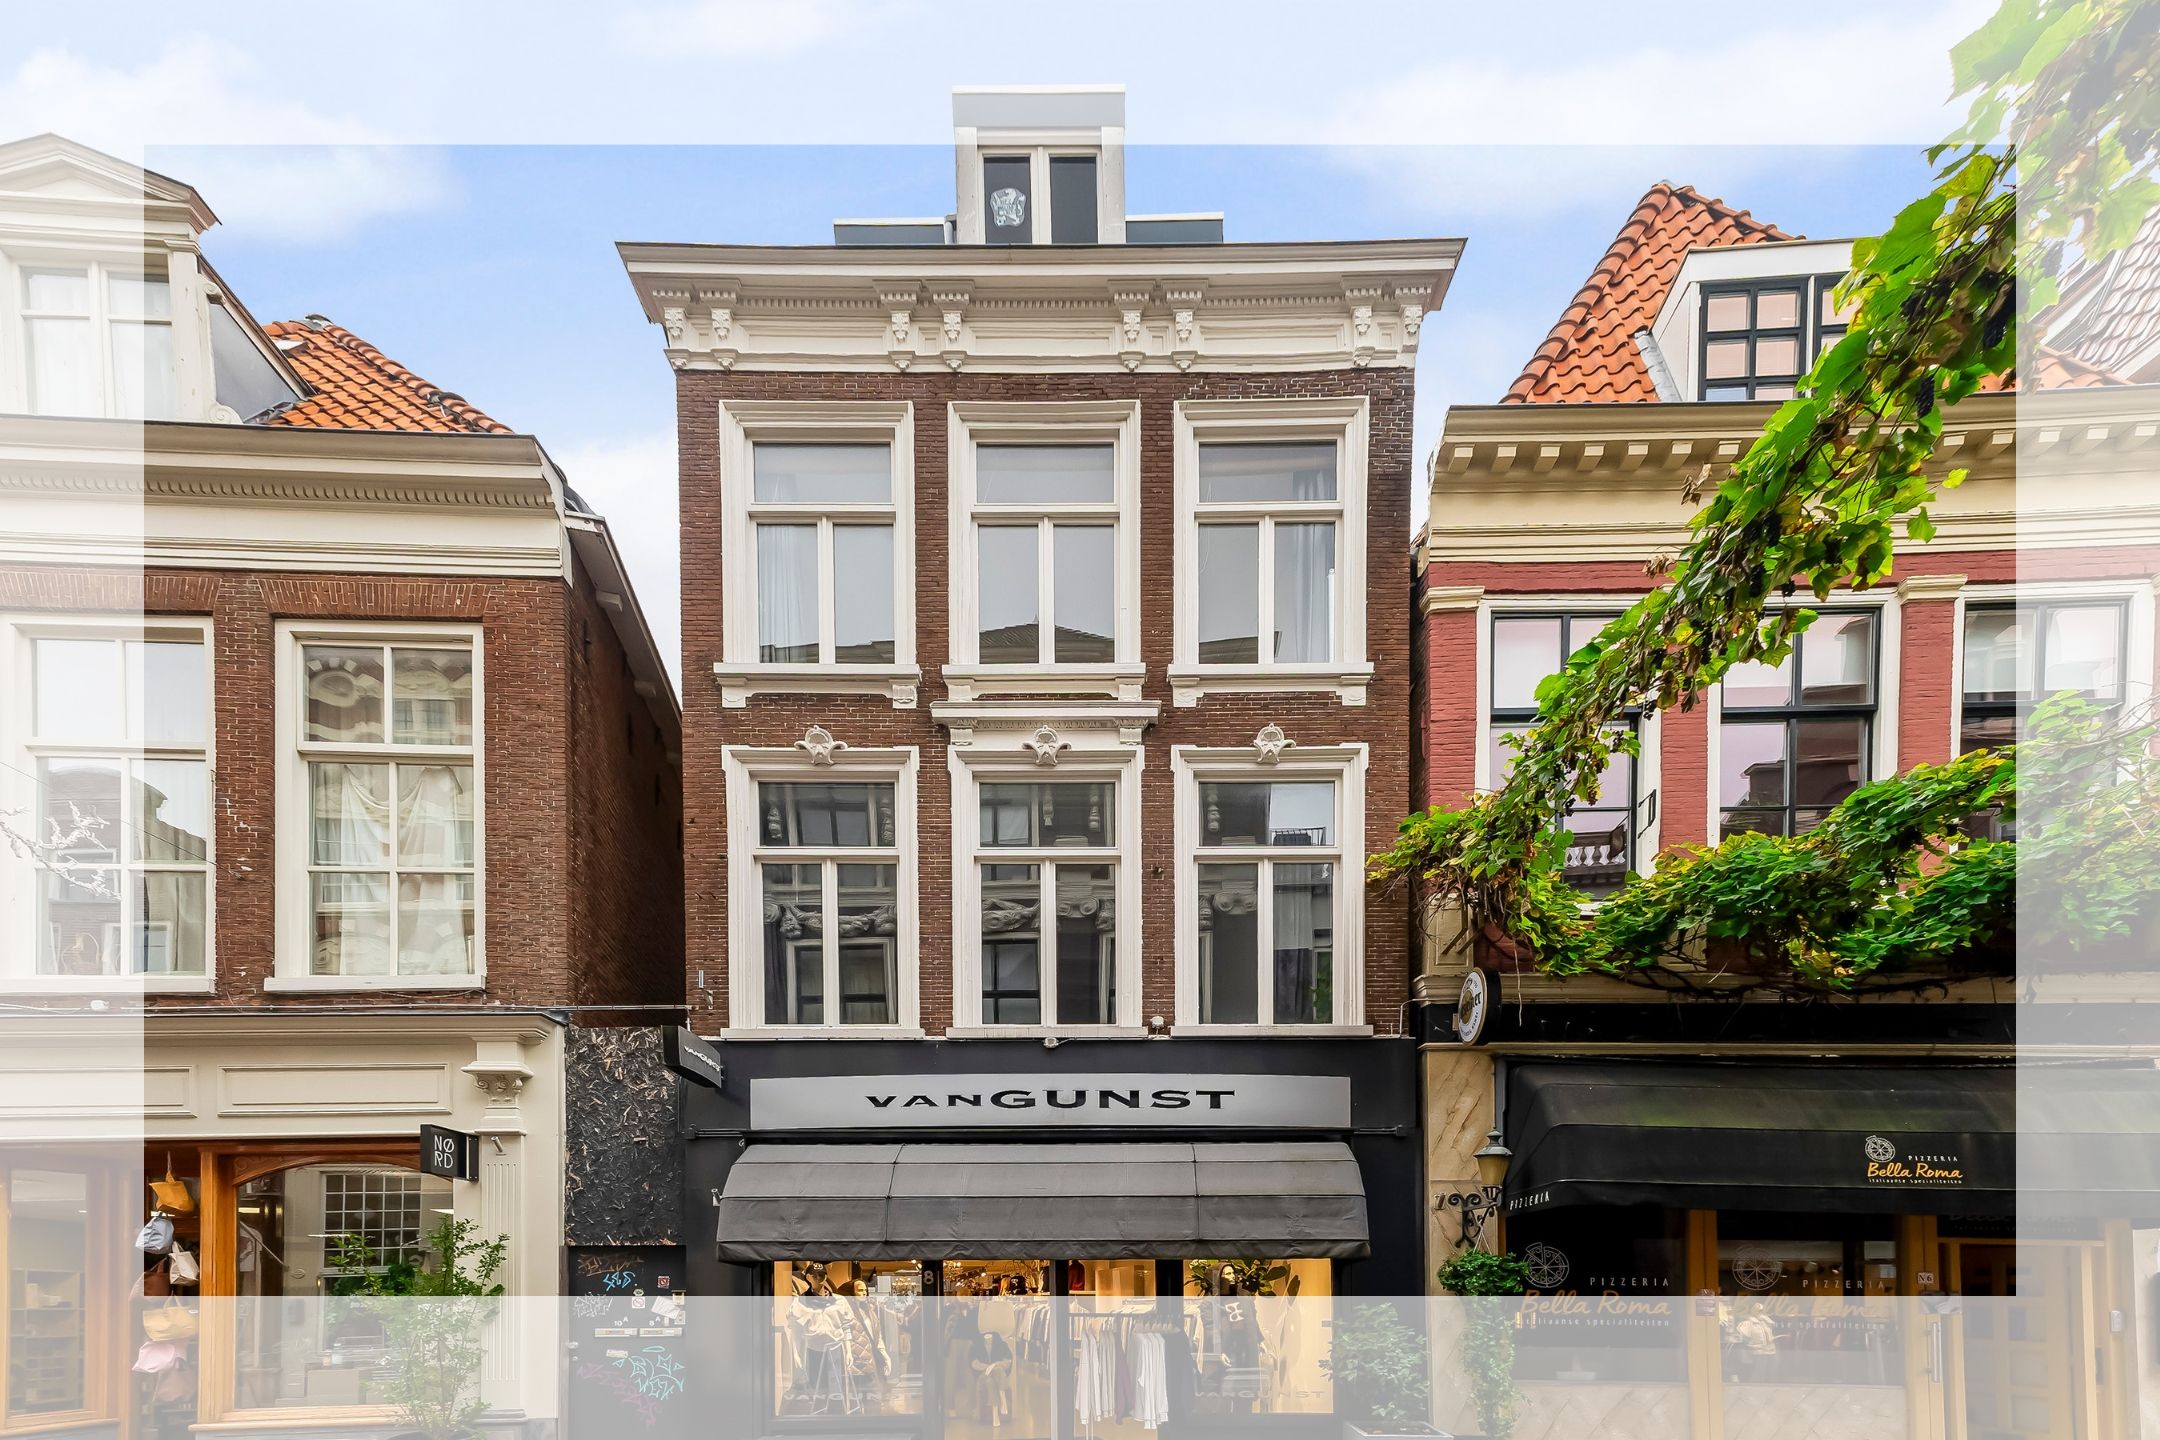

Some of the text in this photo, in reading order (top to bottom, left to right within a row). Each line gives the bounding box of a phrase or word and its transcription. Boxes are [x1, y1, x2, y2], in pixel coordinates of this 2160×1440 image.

[865, 1089, 1236, 1110] VANGUNST
[434, 1150, 454, 1169] RD
[1867, 1162, 1964, 1178] Bella Roma
[1509, 1190, 1551, 1211] PIZZERIA
[923, 1270, 934, 1285] 8
[1589, 1276, 1670, 1287] PIZZERIA
[1802, 1279, 1885, 1289] PIZZERIA
[1520, 1289, 1591, 1314] Bella
[1597, 1289, 1673, 1315] Roma
